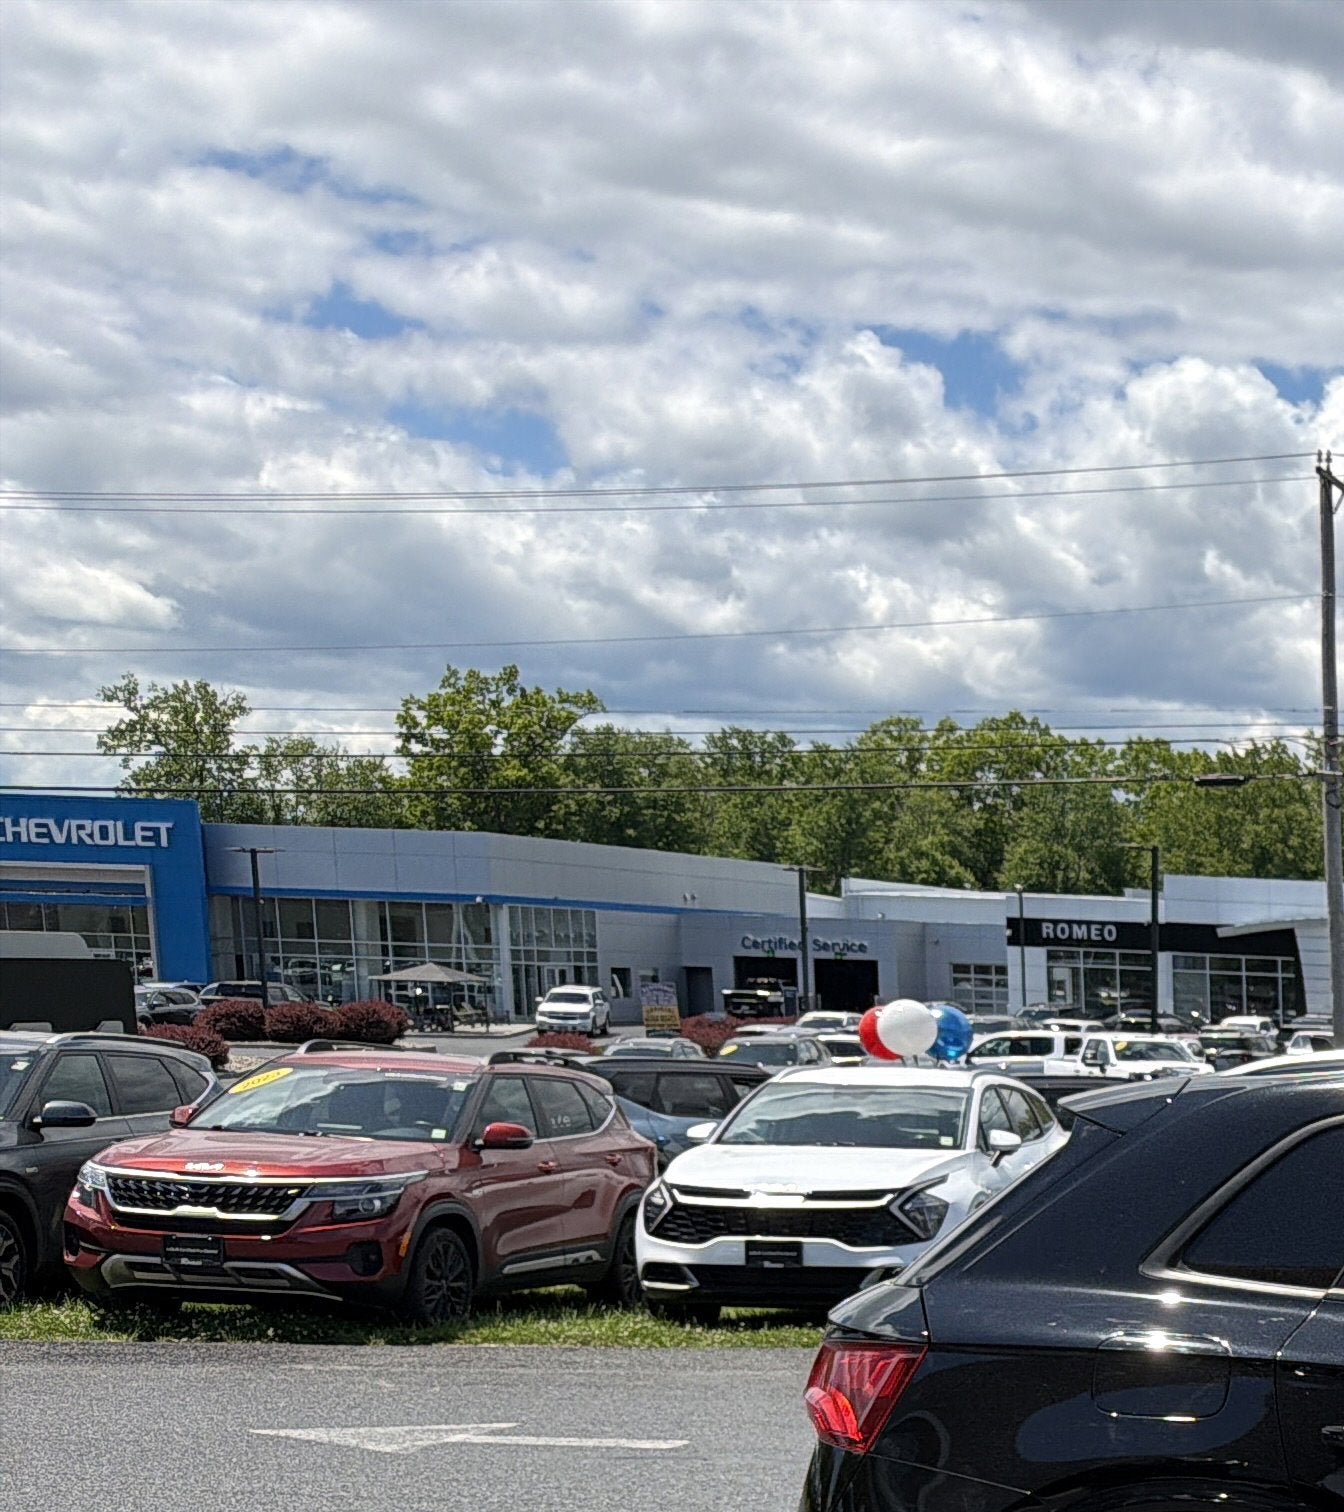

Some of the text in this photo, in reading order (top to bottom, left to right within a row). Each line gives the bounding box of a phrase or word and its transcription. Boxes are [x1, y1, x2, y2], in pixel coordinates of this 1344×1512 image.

[0, 816, 175, 848] HEVROLET
[1042, 922, 1117, 942] ROMEO
[813, 938, 868, 953] Service
